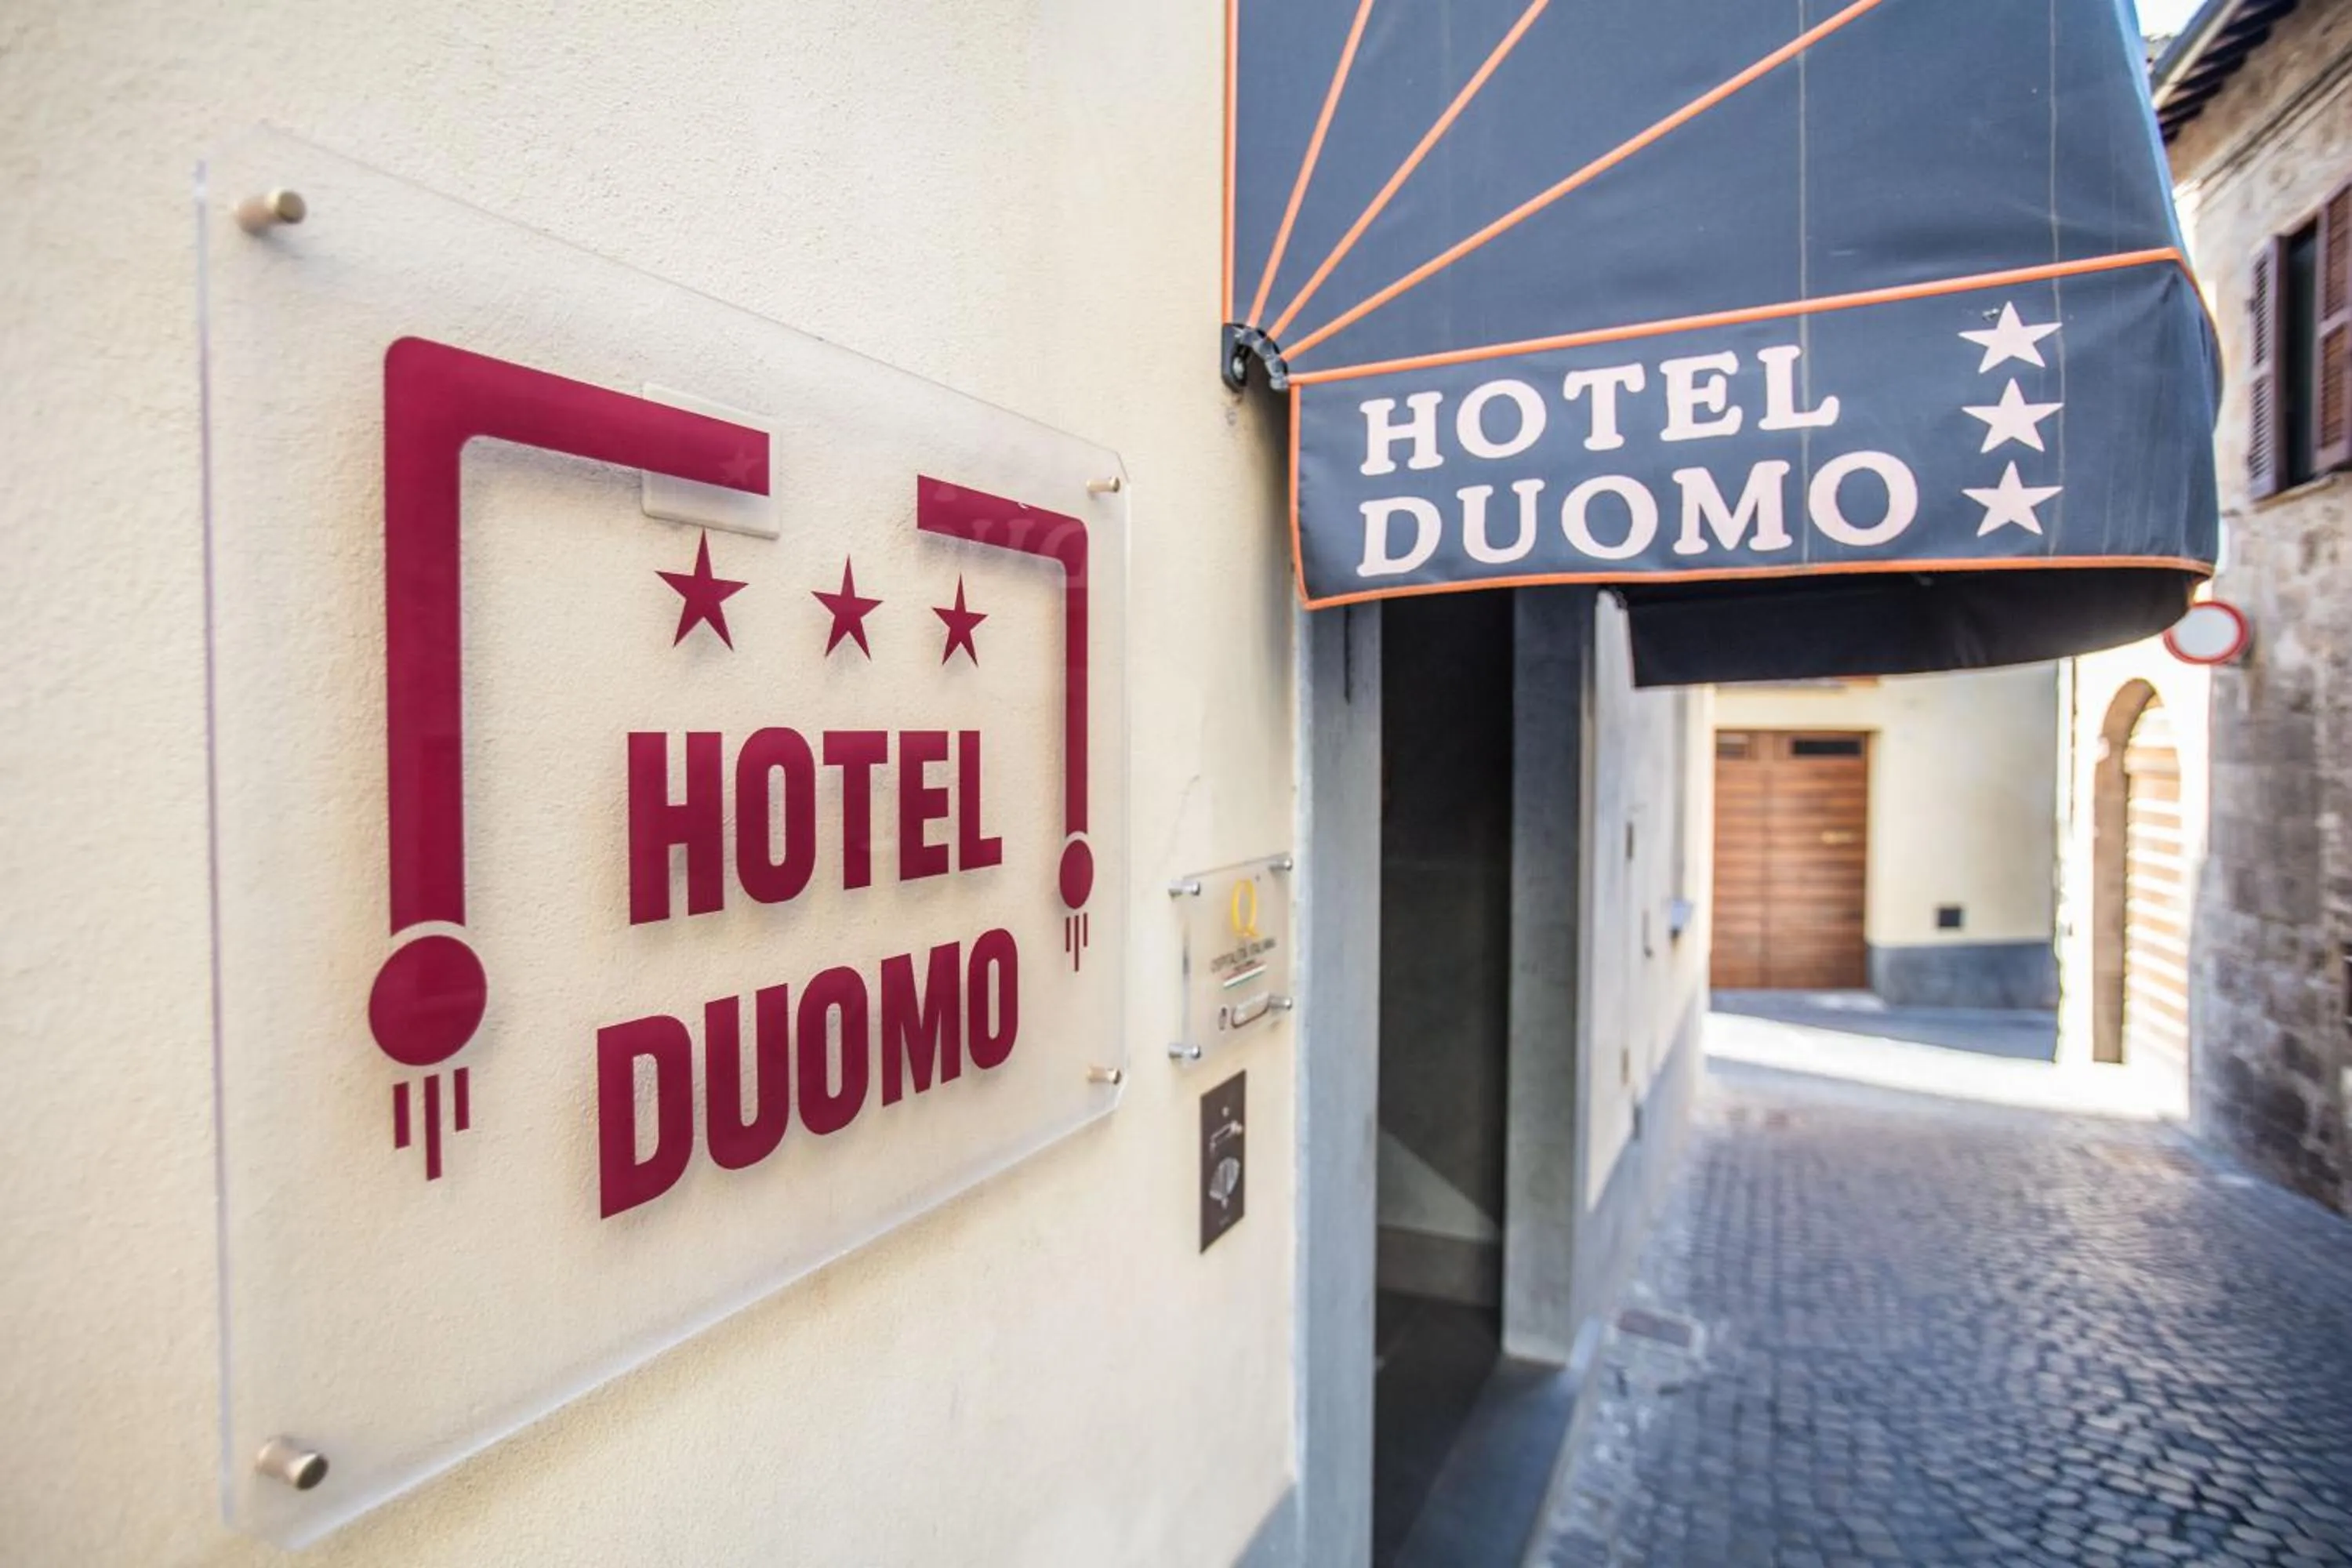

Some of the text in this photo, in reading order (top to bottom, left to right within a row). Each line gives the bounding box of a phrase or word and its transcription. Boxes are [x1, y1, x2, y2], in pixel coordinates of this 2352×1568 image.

[1359, 344, 1841, 477] HOTEL
[1356, 450, 1919, 577] DUOMO
[627, 726, 1003, 926] HOTEL
[597, 927, 1018, 1220] DUOMO
